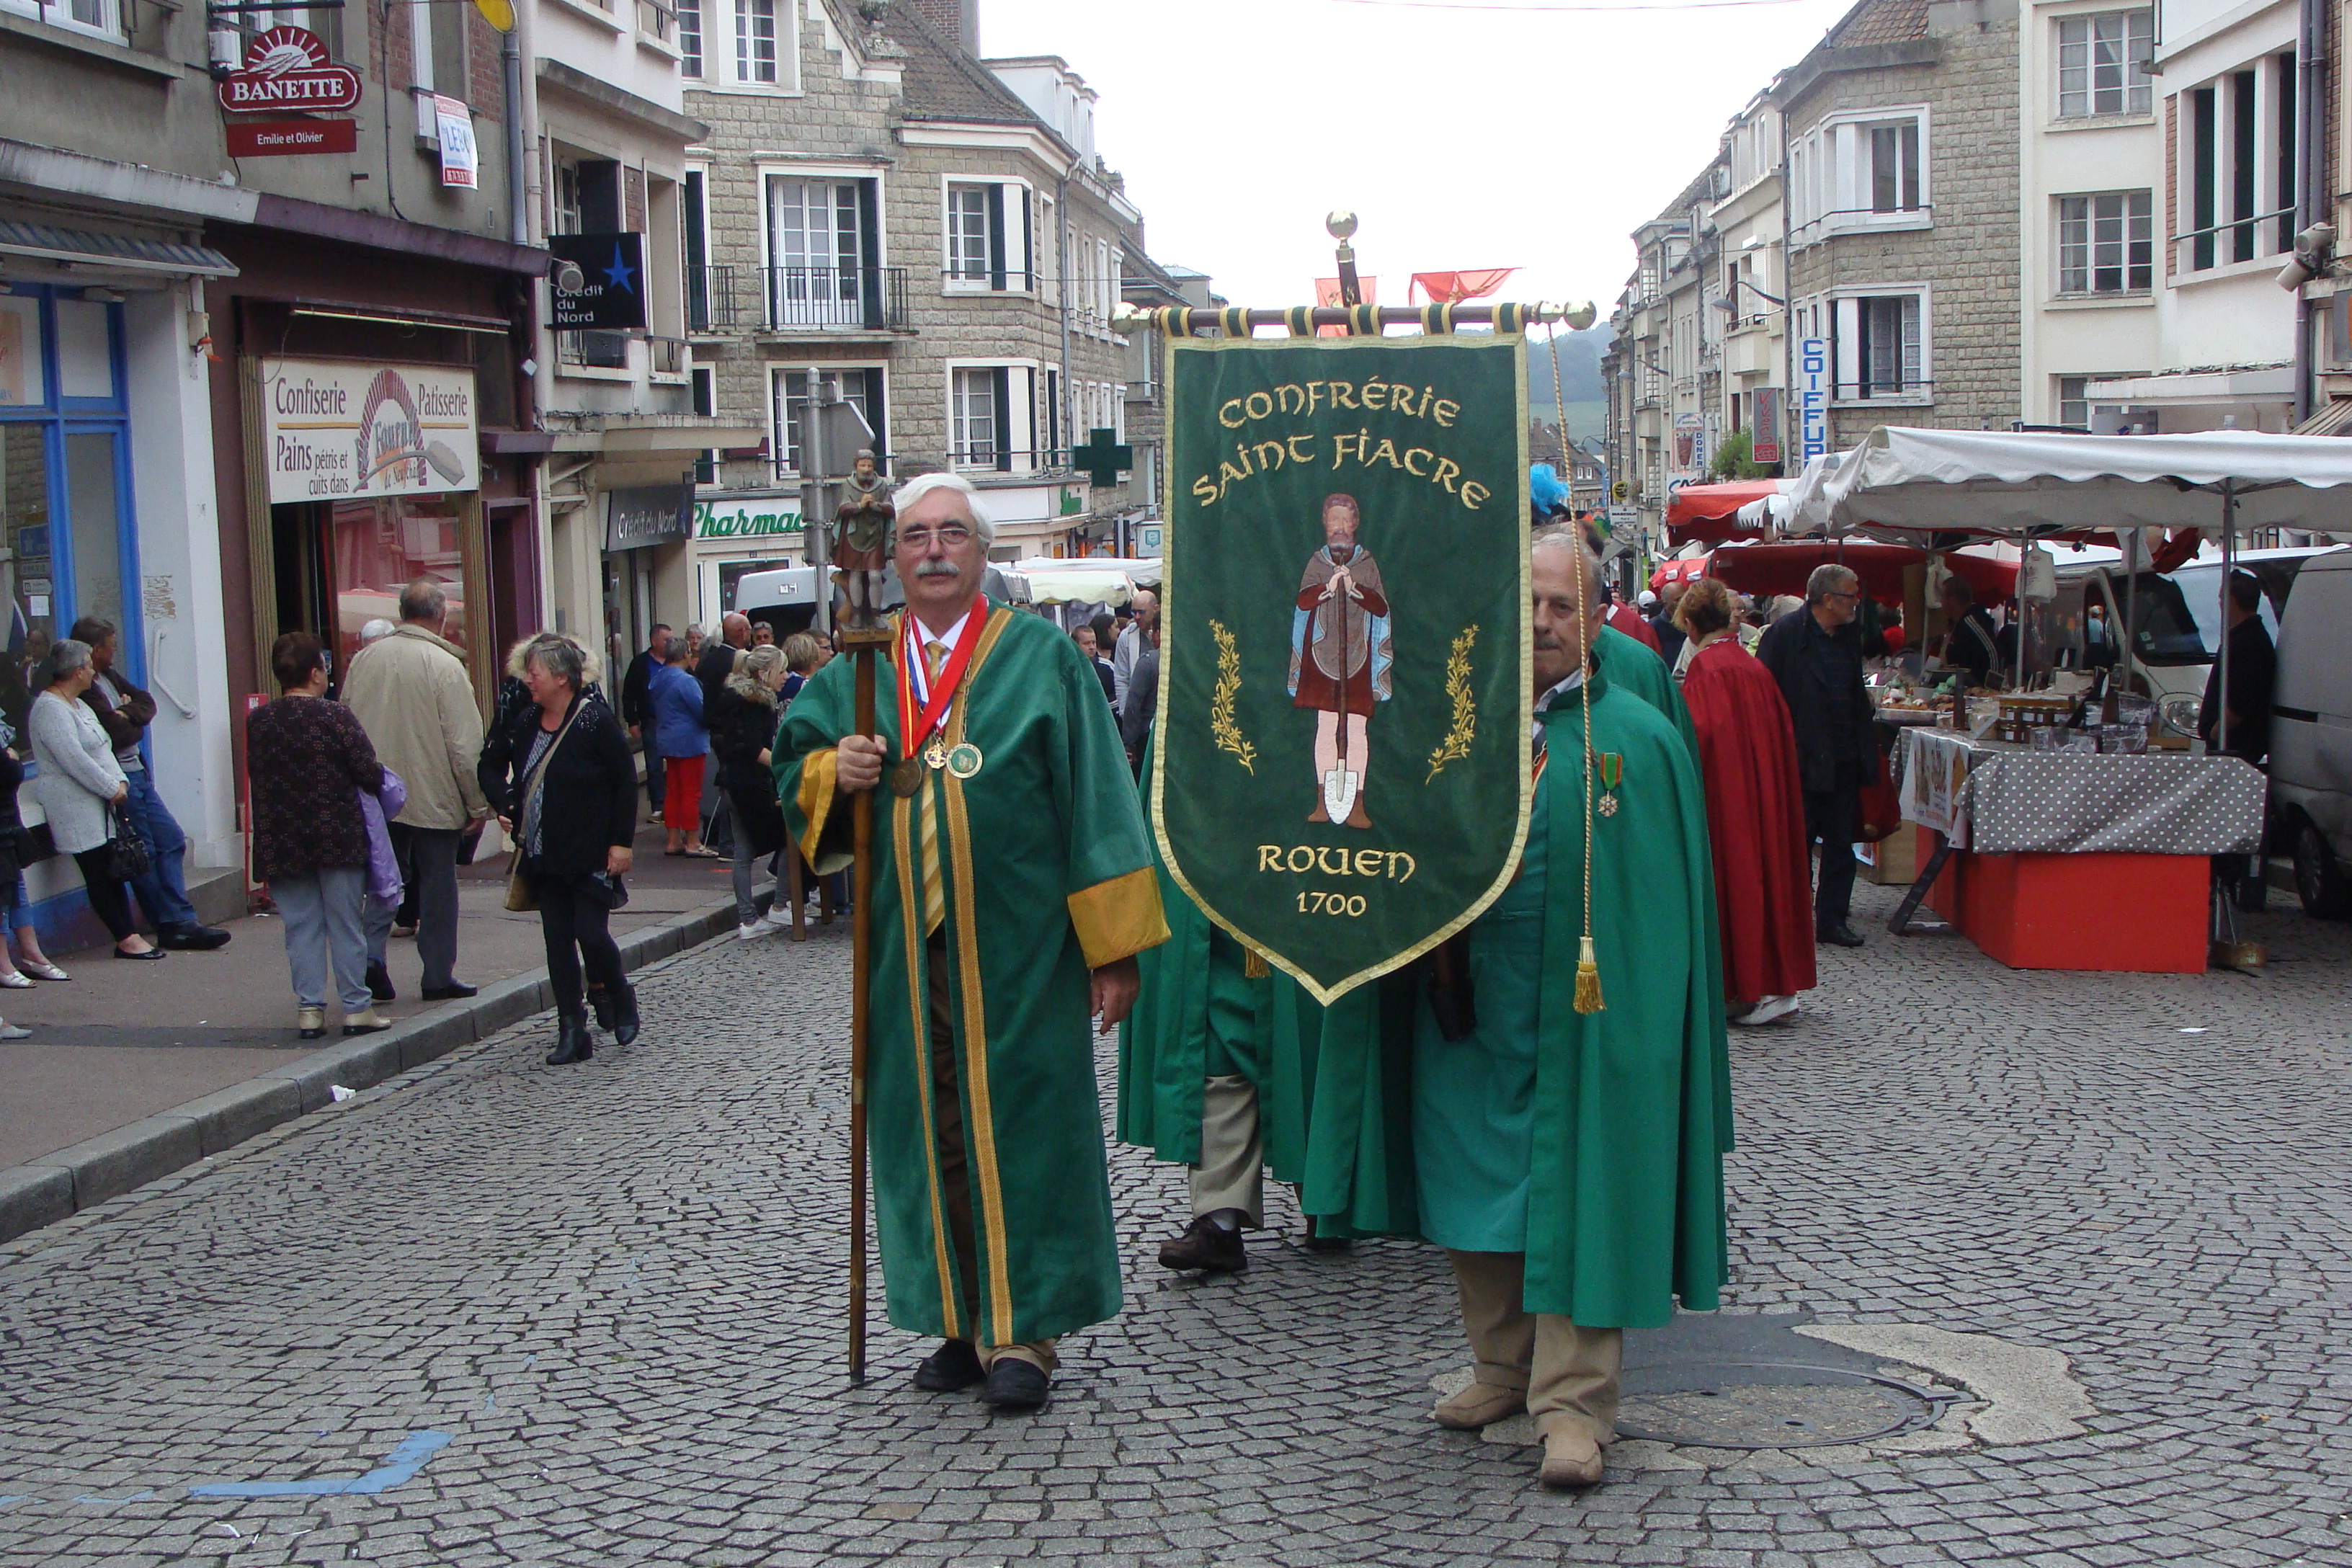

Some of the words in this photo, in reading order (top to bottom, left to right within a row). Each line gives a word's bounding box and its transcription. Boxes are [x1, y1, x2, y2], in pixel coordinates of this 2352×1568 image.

[232, 78, 345, 102] BANETTE
[257, 133, 285, 145] Emilie
[286, 133, 294, 144] et
[296, 131, 324, 143] Olivier
[557, 298, 576, 310] du
[558, 311, 594, 324] Nord
[276, 377, 347, 415] Confiserie
[418, 383, 468, 416] Patisserie
[1803, 339, 1825, 469] COIFFUR
[276, 435, 313, 471] Pains
[315, 448, 338, 476] pétris
[339, 450, 348, 468] et
[308, 473, 329, 495] cuits
[330, 472, 349, 494] dans
[618, 510, 645, 539] Crédit
[646, 510, 656, 534] du
[657, 507, 677, 534] Nord
[1257, 845, 1417, 883] ROUEN
[1296, 891, 1367, 917] 1700
